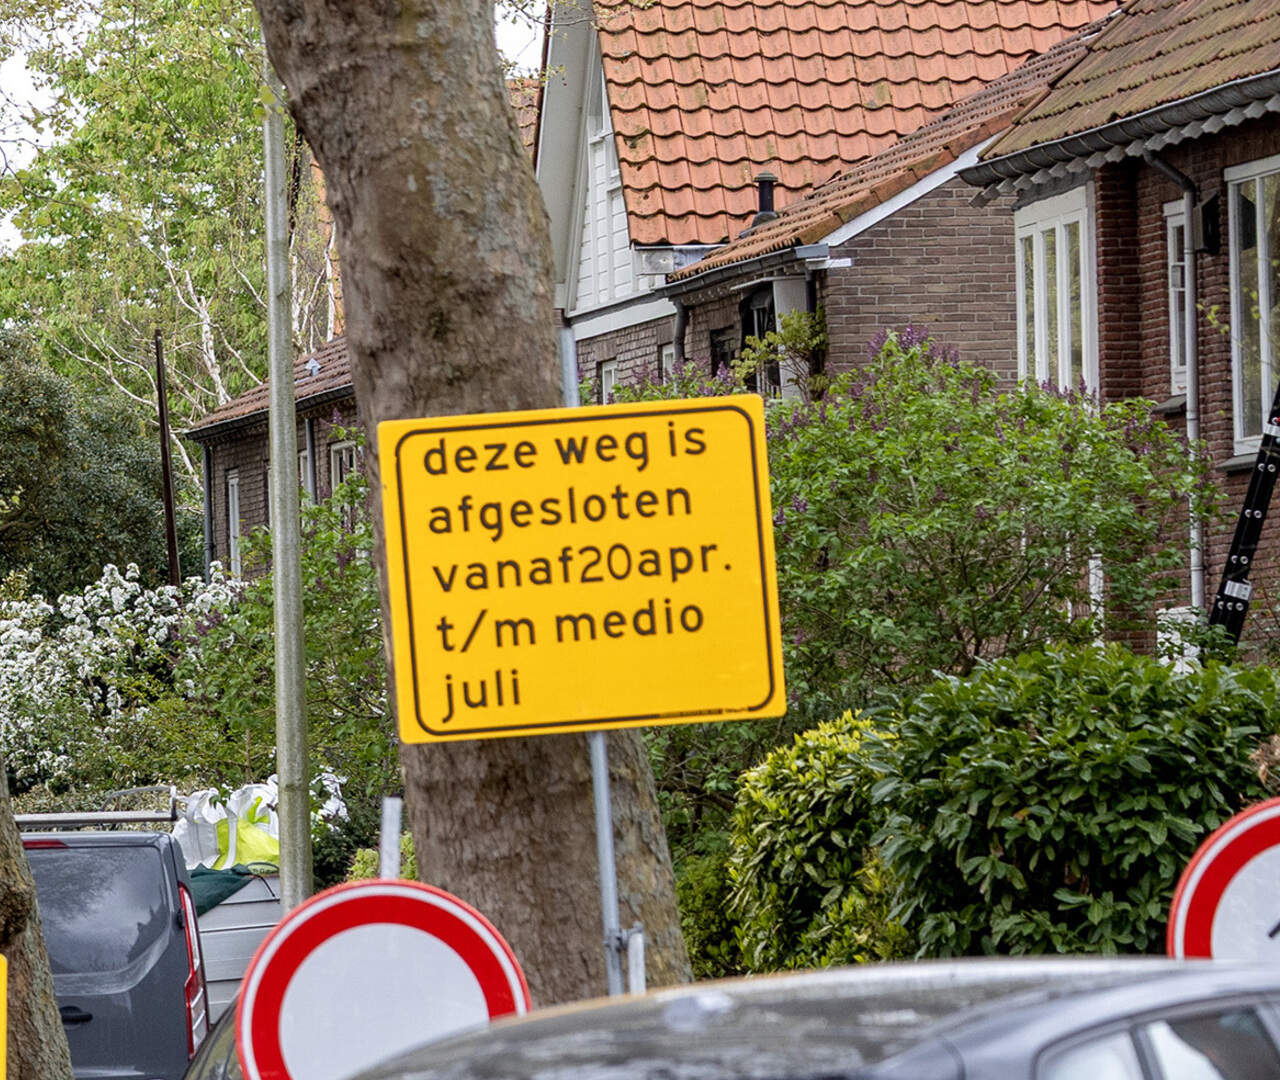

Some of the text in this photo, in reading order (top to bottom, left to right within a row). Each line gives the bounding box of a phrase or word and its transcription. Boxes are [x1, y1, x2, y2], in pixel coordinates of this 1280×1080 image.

[423, 421, 706, 476] deze weg is
[429, 485, 691, 542] afgesloten
[436, 598, 704, 653] t/m medio
[442, 669, 520, 724] juli
